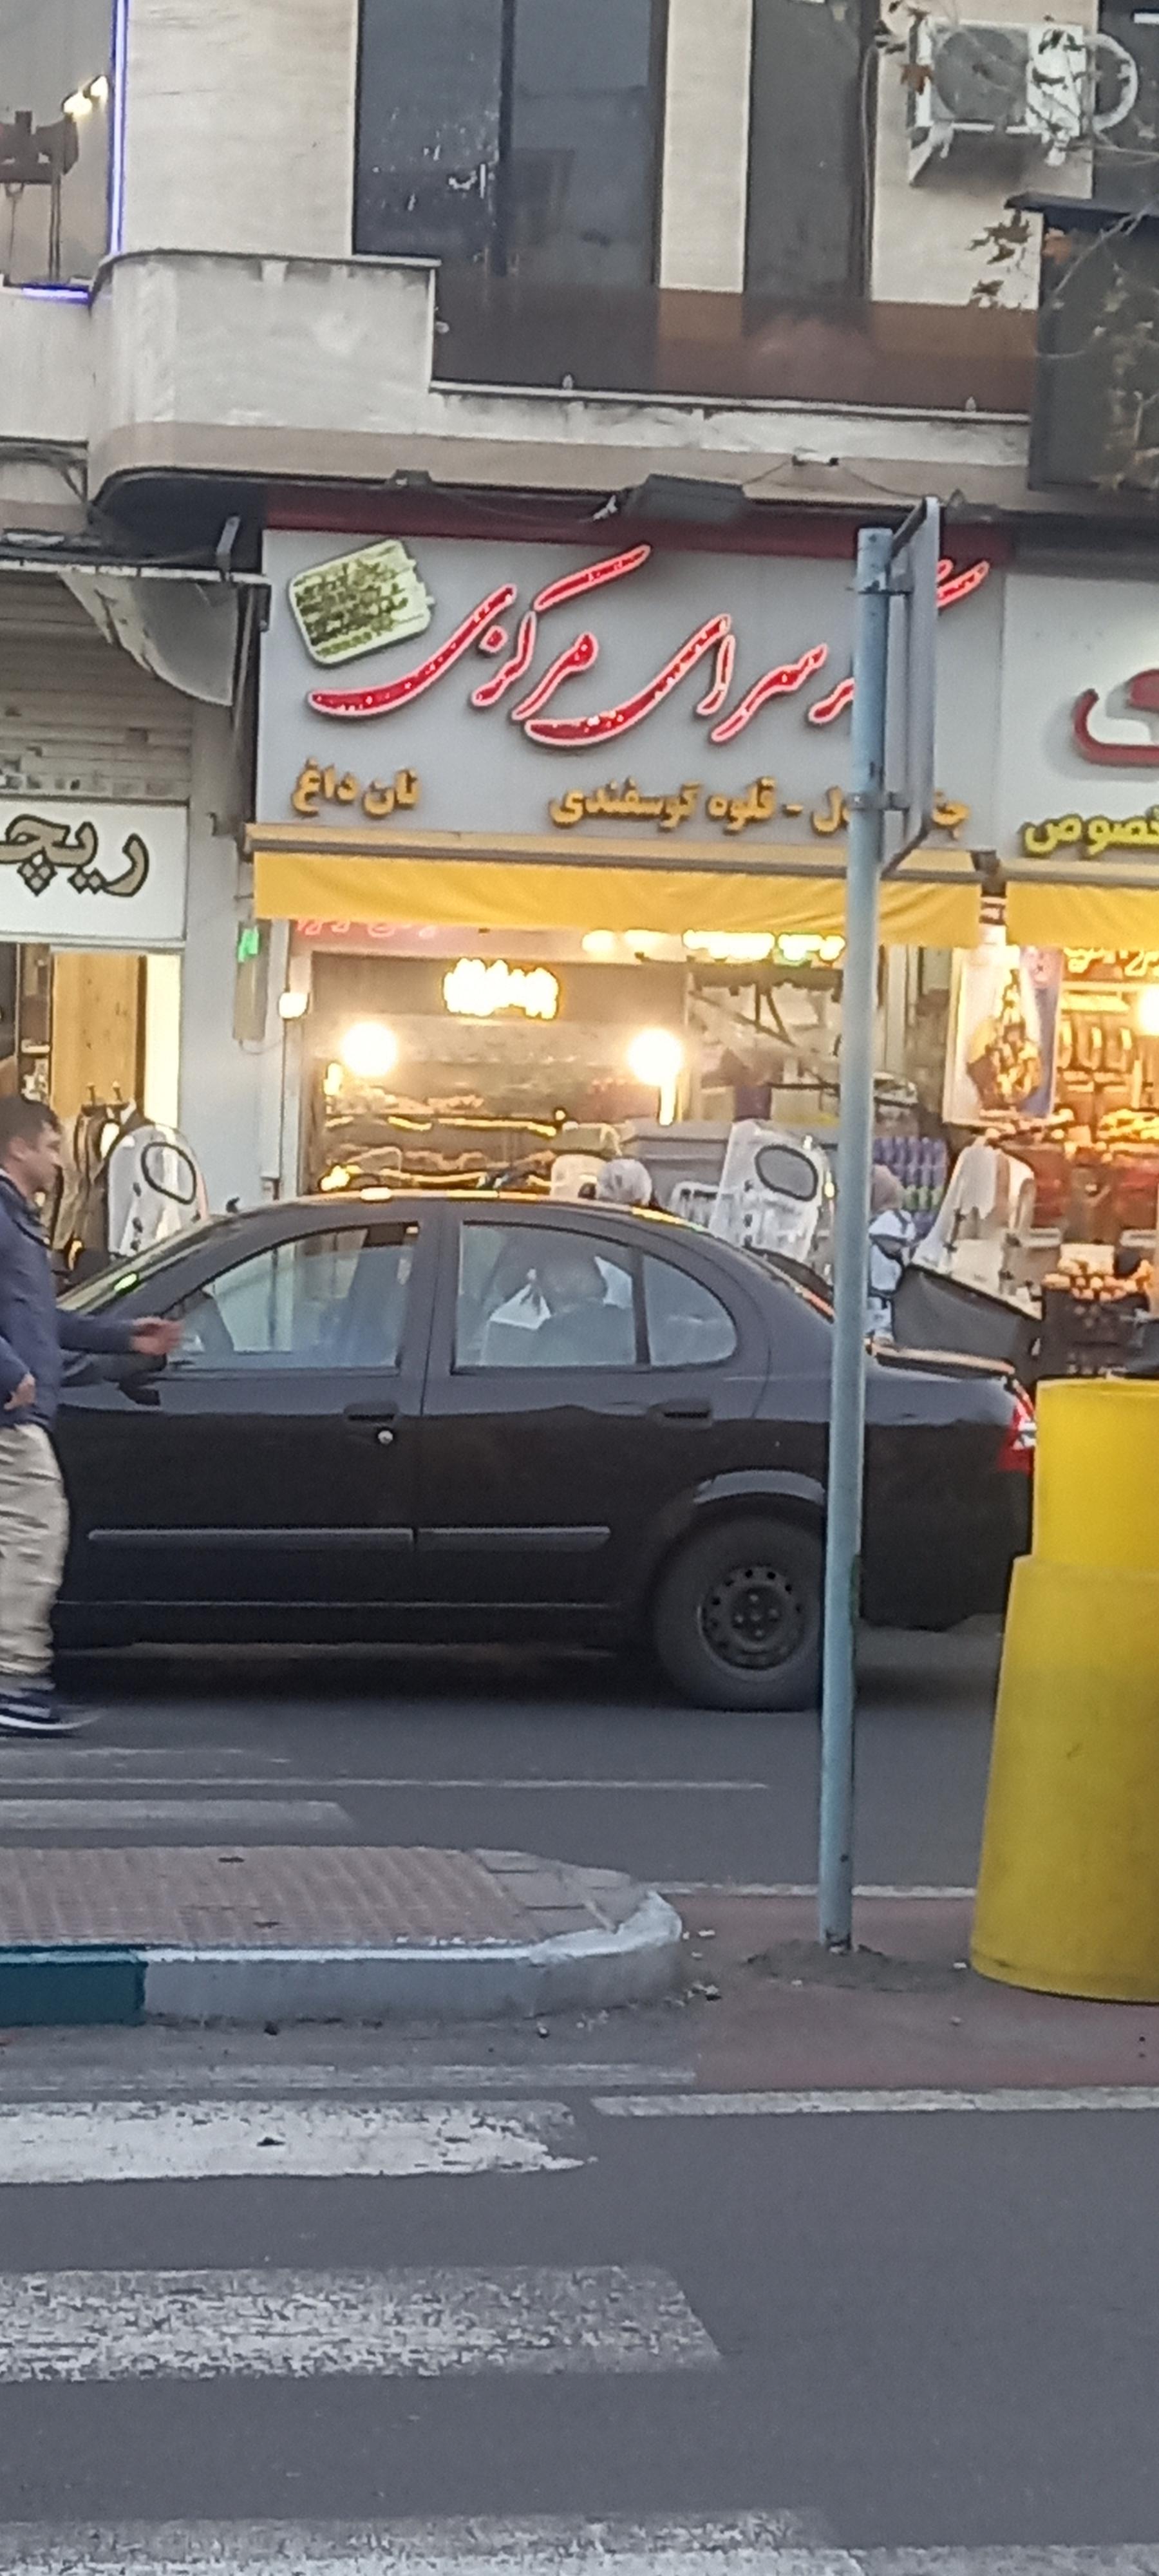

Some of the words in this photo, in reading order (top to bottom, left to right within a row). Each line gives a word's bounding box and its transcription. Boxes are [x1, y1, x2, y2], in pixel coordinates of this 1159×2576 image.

[308, 544, 652, 721] مرکزی
[292, 757, 358, 815] داغ
[364, 767, 420, 816] نان
[550, 775, 701, 831] گوسفندی
[706, 775, 776, 834] قلوه
